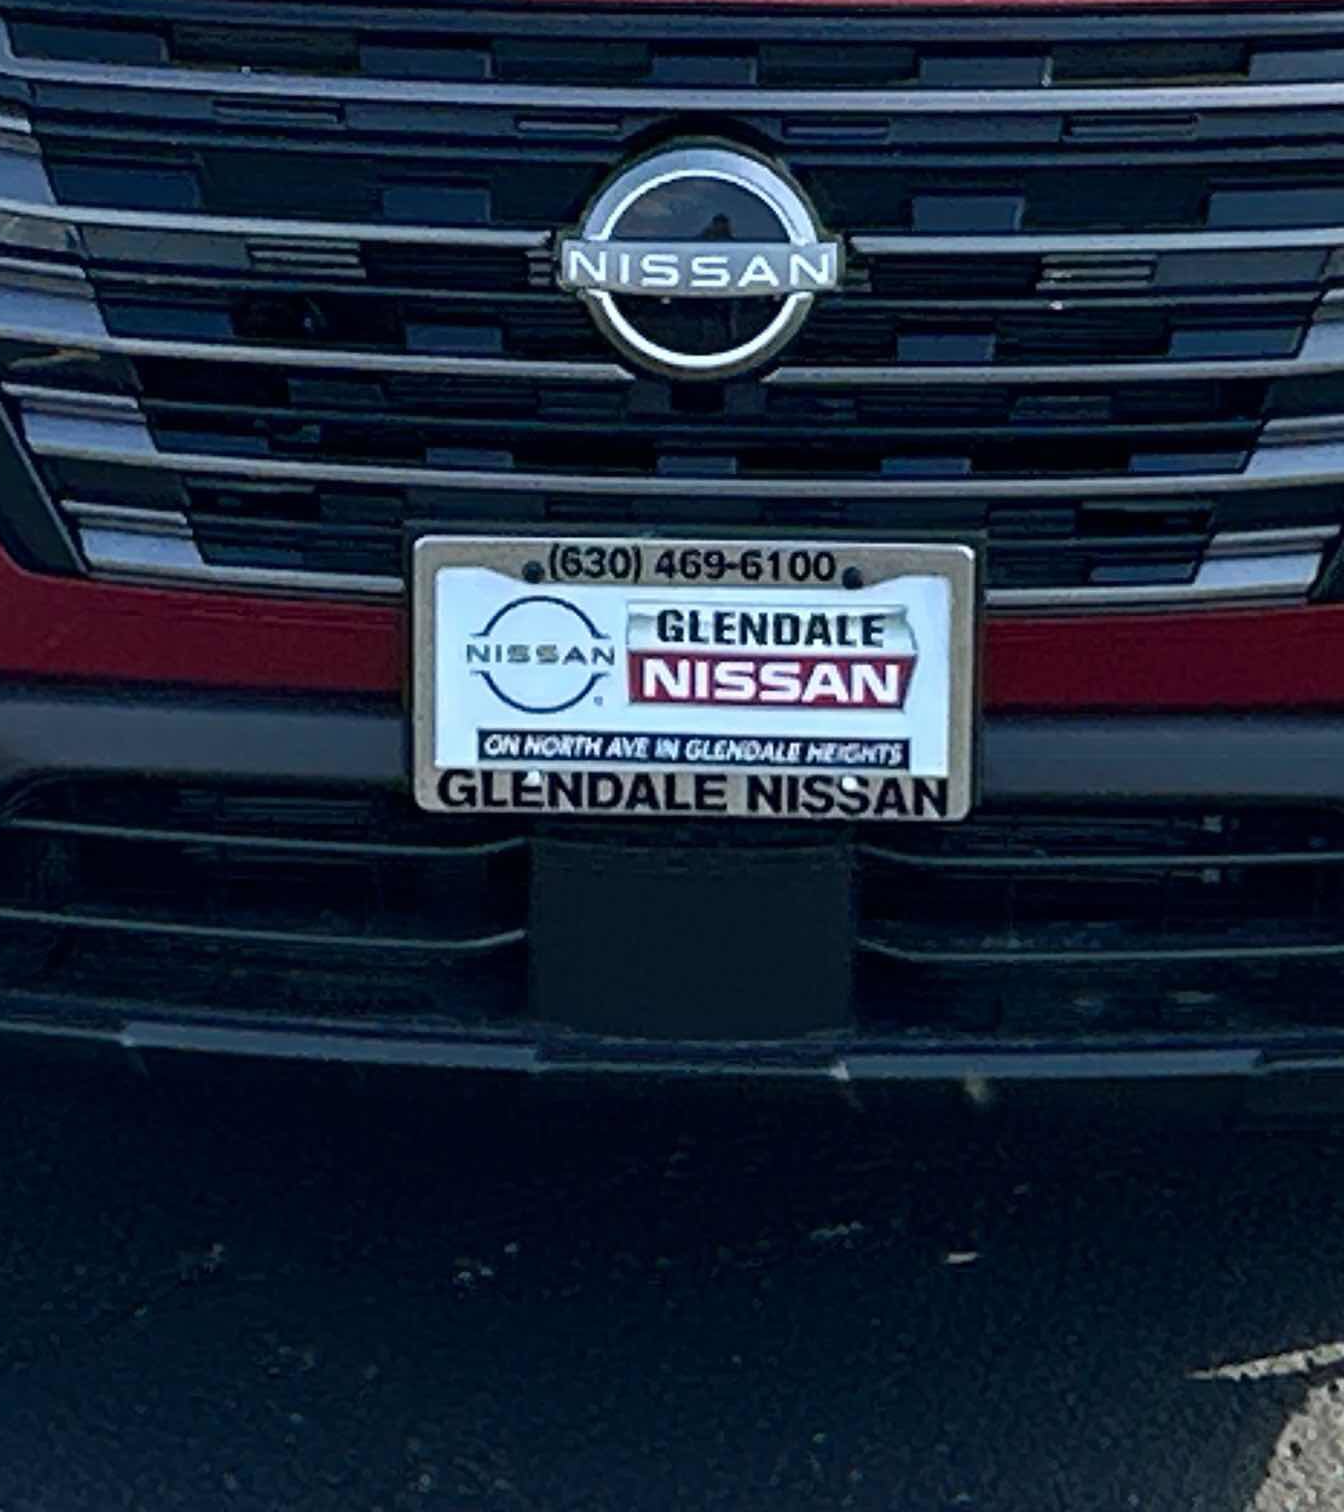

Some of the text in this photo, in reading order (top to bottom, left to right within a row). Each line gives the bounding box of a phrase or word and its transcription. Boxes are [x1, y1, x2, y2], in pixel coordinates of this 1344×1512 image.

[568, 249, 829, 288] NISSAN
[549, 543, 837, 584] (630) 469-6100
[656, 608, 886, 648] GLENDALE
[465, 642, 616, 667] NISSAN
[642, 658, 900, 705] NISSAN
[483, 733, 904, 767] ON NORTH AVE IN GLENDALE HEIGHTS
[436, 769, 949, 819] GLENDALE NISSAN
